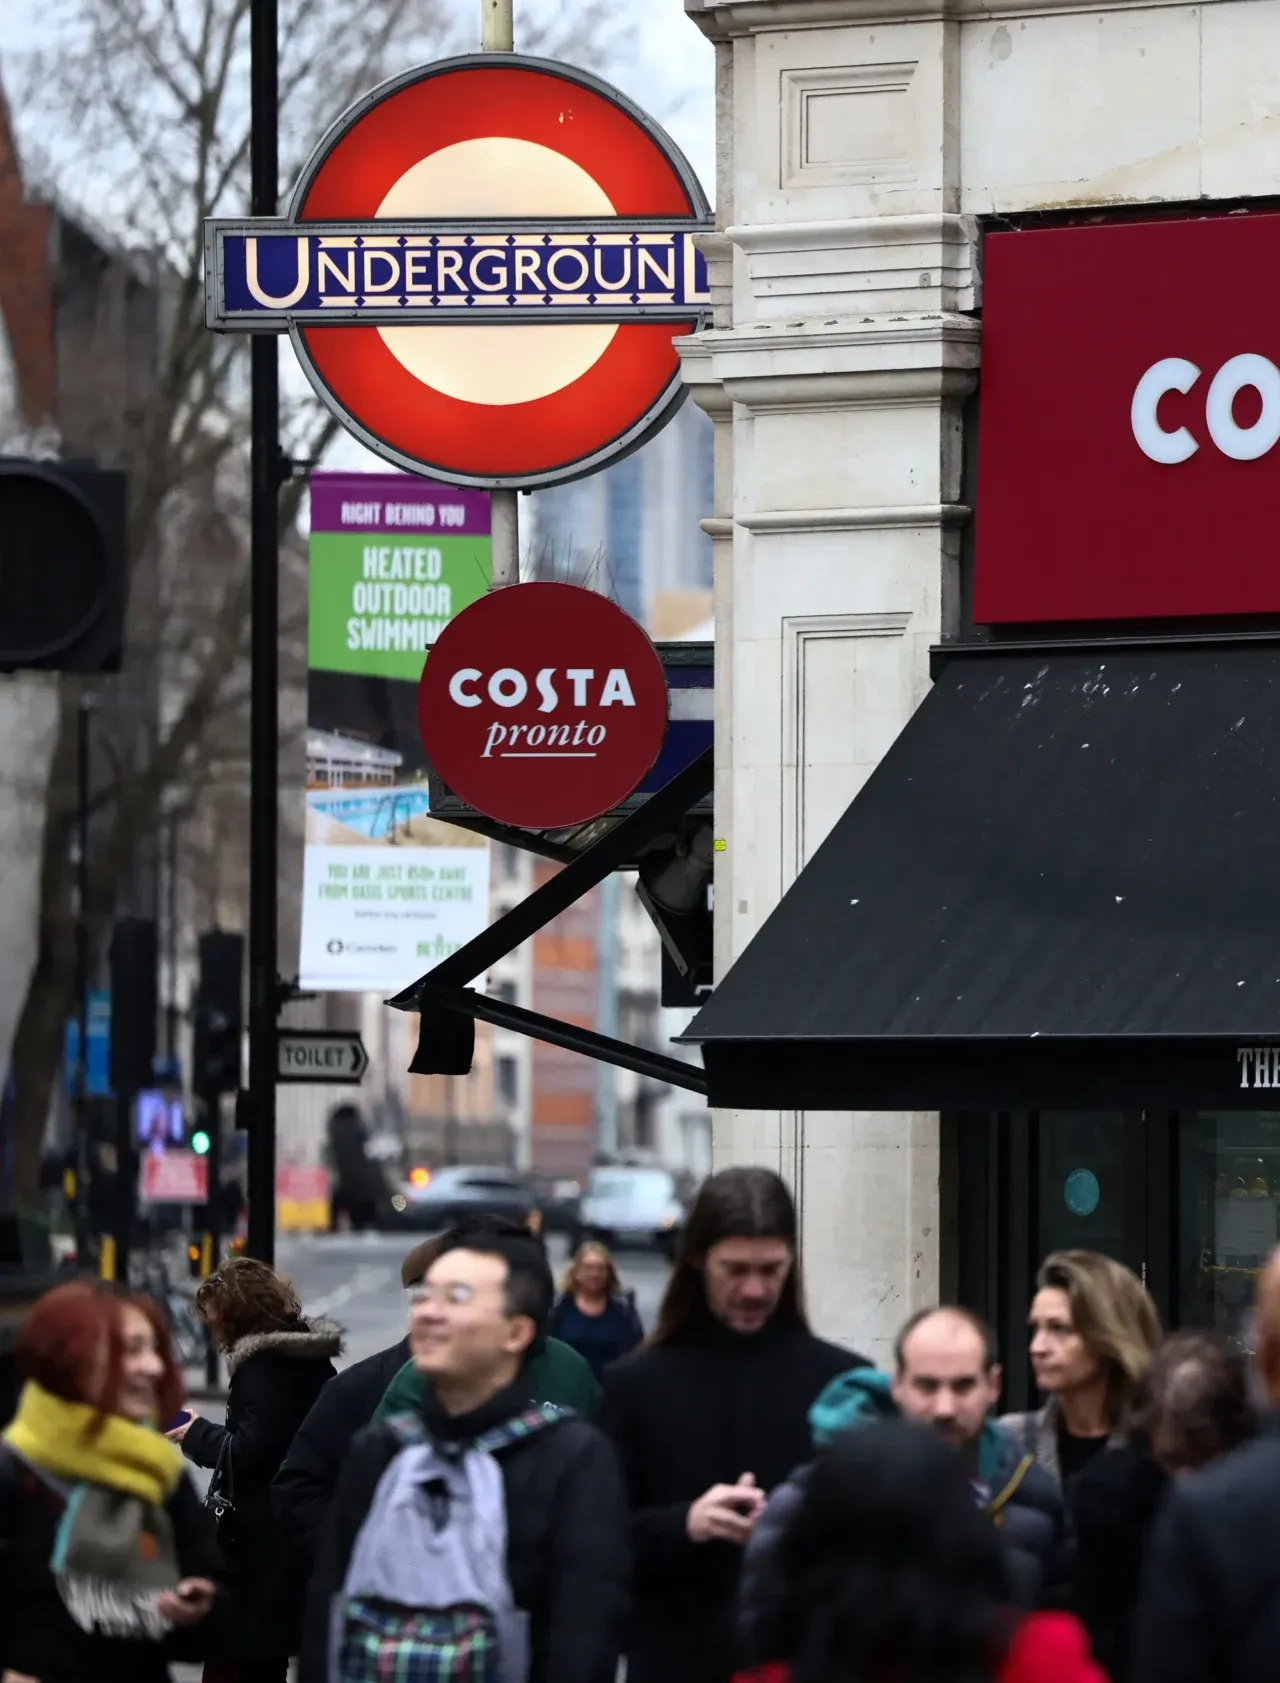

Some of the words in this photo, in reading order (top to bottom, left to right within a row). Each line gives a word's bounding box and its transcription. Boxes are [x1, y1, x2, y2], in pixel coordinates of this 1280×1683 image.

[341, 501, 380, 525] RIGHT
[385, 502, 435, 527] BEHIND
[438, 504, 465, 527] YOU
[362, 547, 442, 581] HEATED
[352, 582, 452, 617] OUTDOOR
[346, 617, 448, 652] SWIMMIN
[448, 667, 636, 714] COSTA
[480, 719, 607, 758] pronto
[285, 1045, 345, 1068] TOILET
